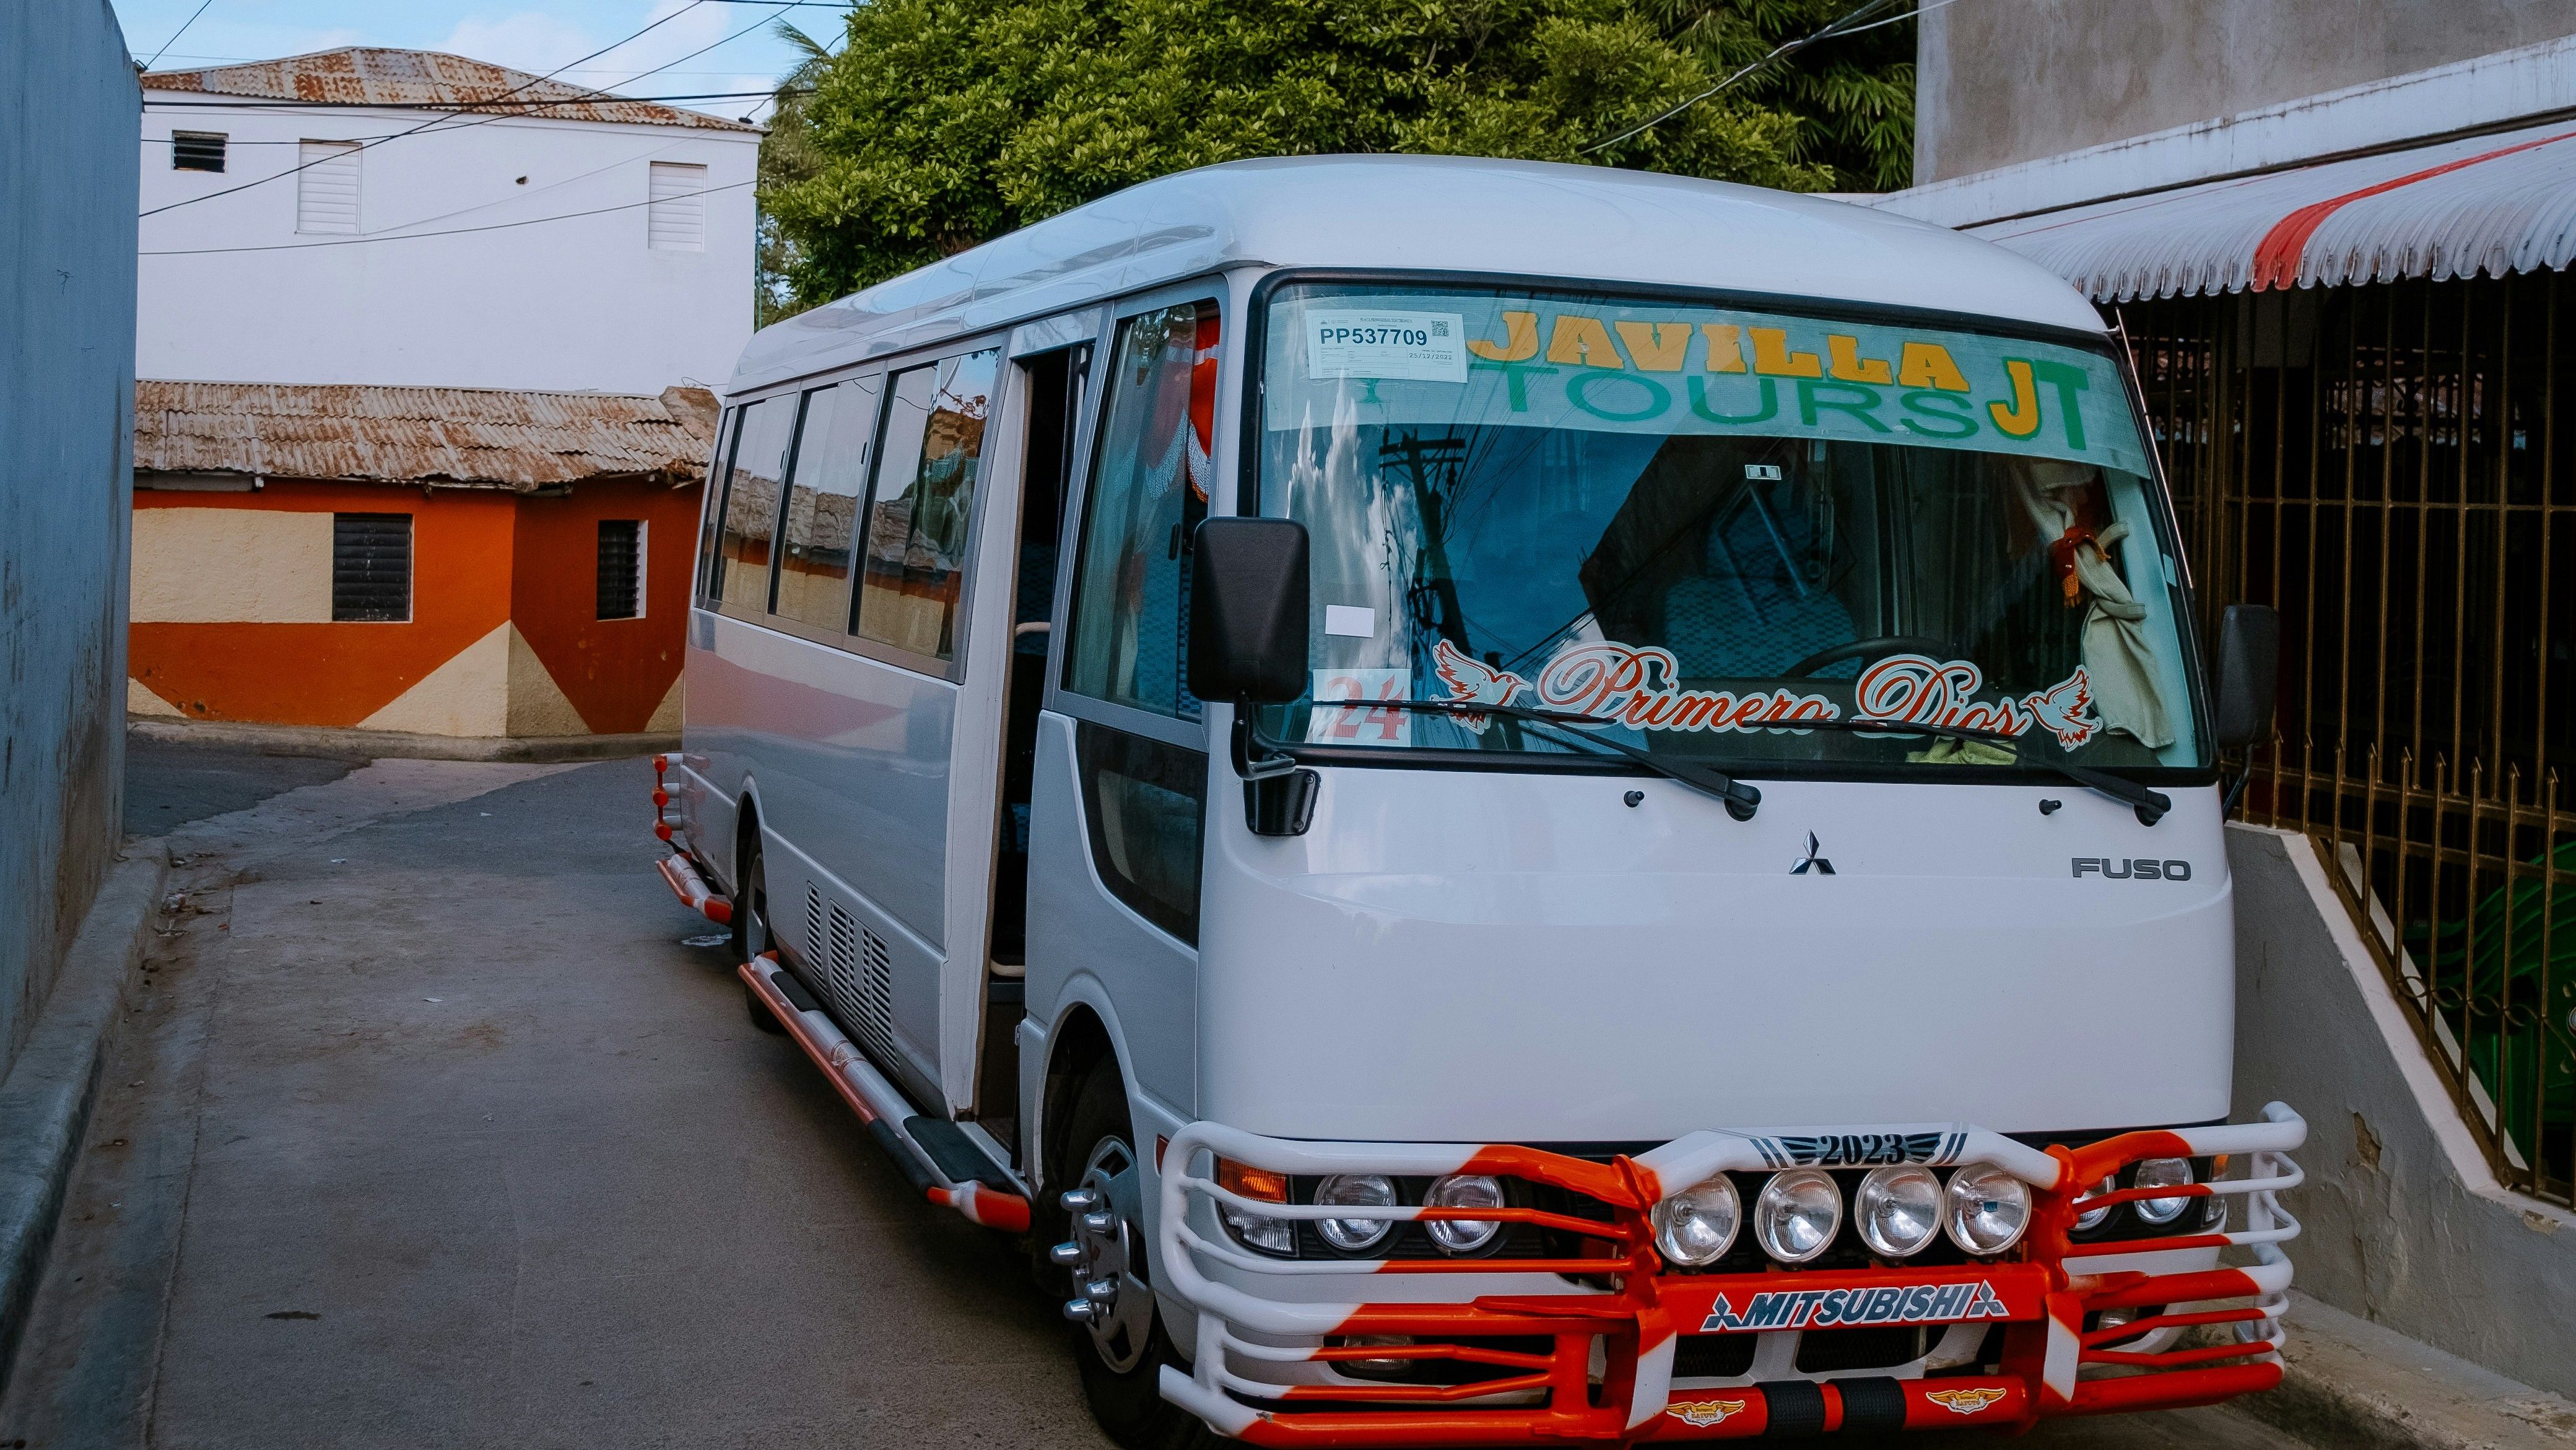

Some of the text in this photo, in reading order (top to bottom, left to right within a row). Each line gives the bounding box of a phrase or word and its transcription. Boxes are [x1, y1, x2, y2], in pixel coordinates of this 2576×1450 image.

[1320, 328, 1427, 346] PP537709
[1466, 311, 1970, 393] JAVILLA
[1469, 362, 1980, 439] TOURS
[1986, 357, 2089, 451] JT
[1323, 672, 1410, 740] 24
[1542, 645, 2029, 735] Primero Dios
[2071, 857, 2191, 881] FUSO
[1819, 1134, 1907, 1166] 2023
[1741, 1282, 1976, 1328] MITSUBISHI
